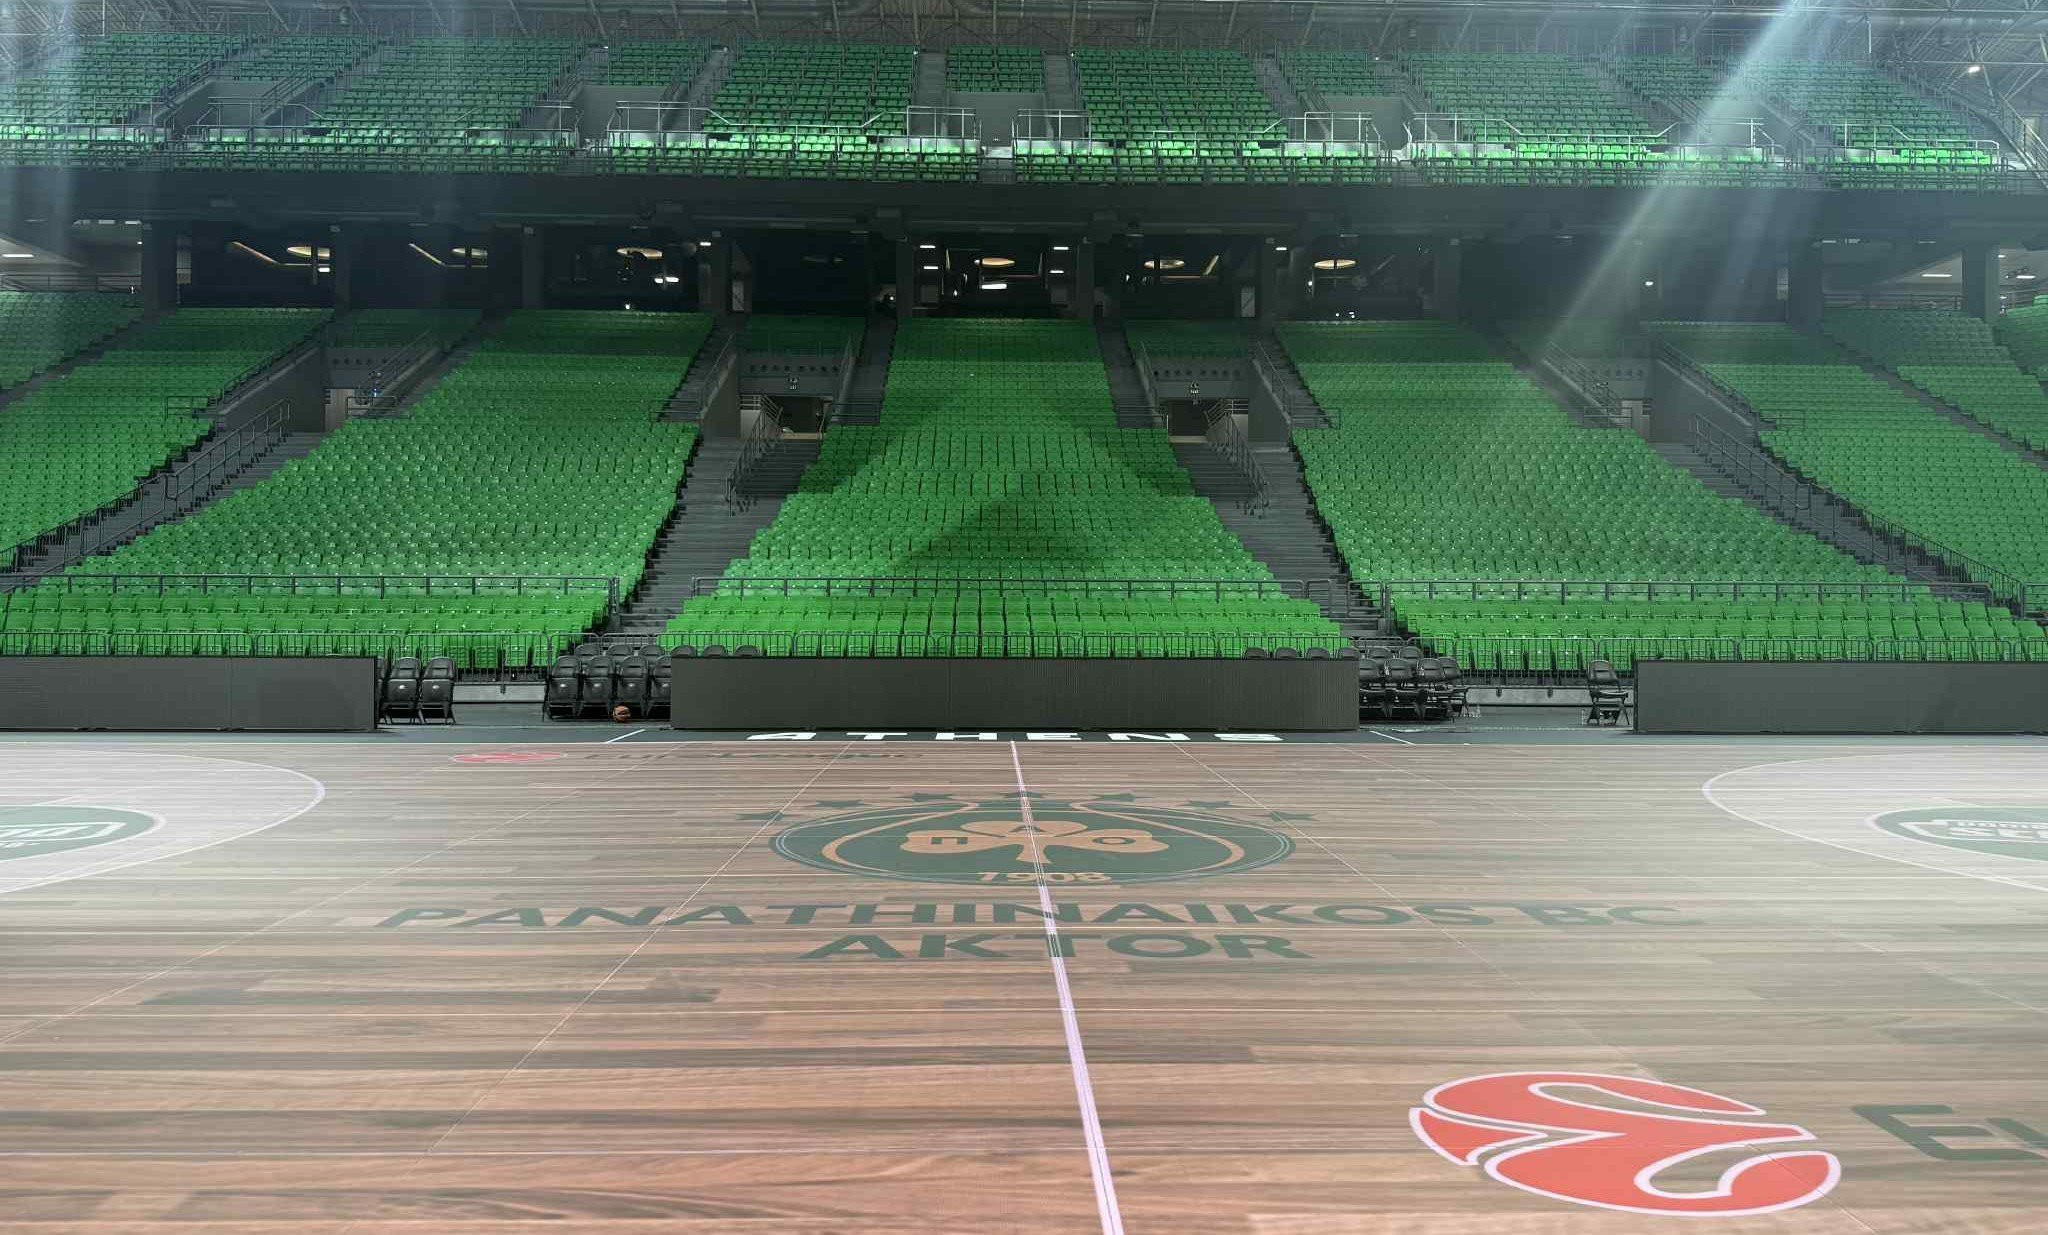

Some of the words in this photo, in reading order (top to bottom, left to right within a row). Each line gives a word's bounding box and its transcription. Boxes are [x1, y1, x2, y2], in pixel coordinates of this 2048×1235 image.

[746, 732, 1284, 741] ATHENS
[977, 872, 1112, 883] 1908
[373, 904, 1496, 927] PANATHINAIKOS
[1503, 903, 1707, 926] BC
[800, 934, 1314, 959] AKTOR
